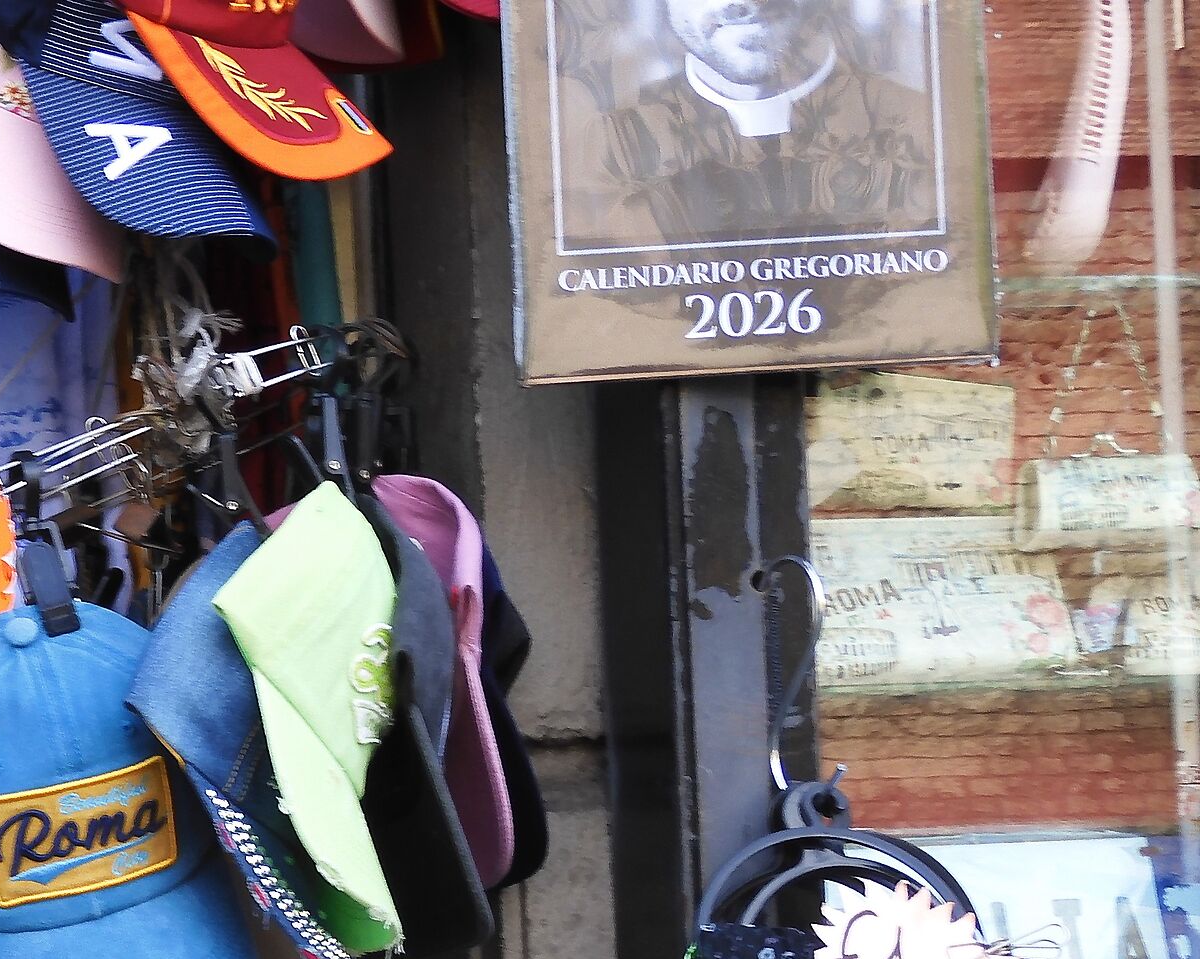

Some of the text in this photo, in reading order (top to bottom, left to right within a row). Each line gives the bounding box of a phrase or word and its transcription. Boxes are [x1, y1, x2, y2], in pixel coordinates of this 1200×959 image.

[557, 249, 949, 292] CALENDARIO GREGORIANO
[684, 288, 822, 339] 2026
[823, 577, 903, 617] ROMA
